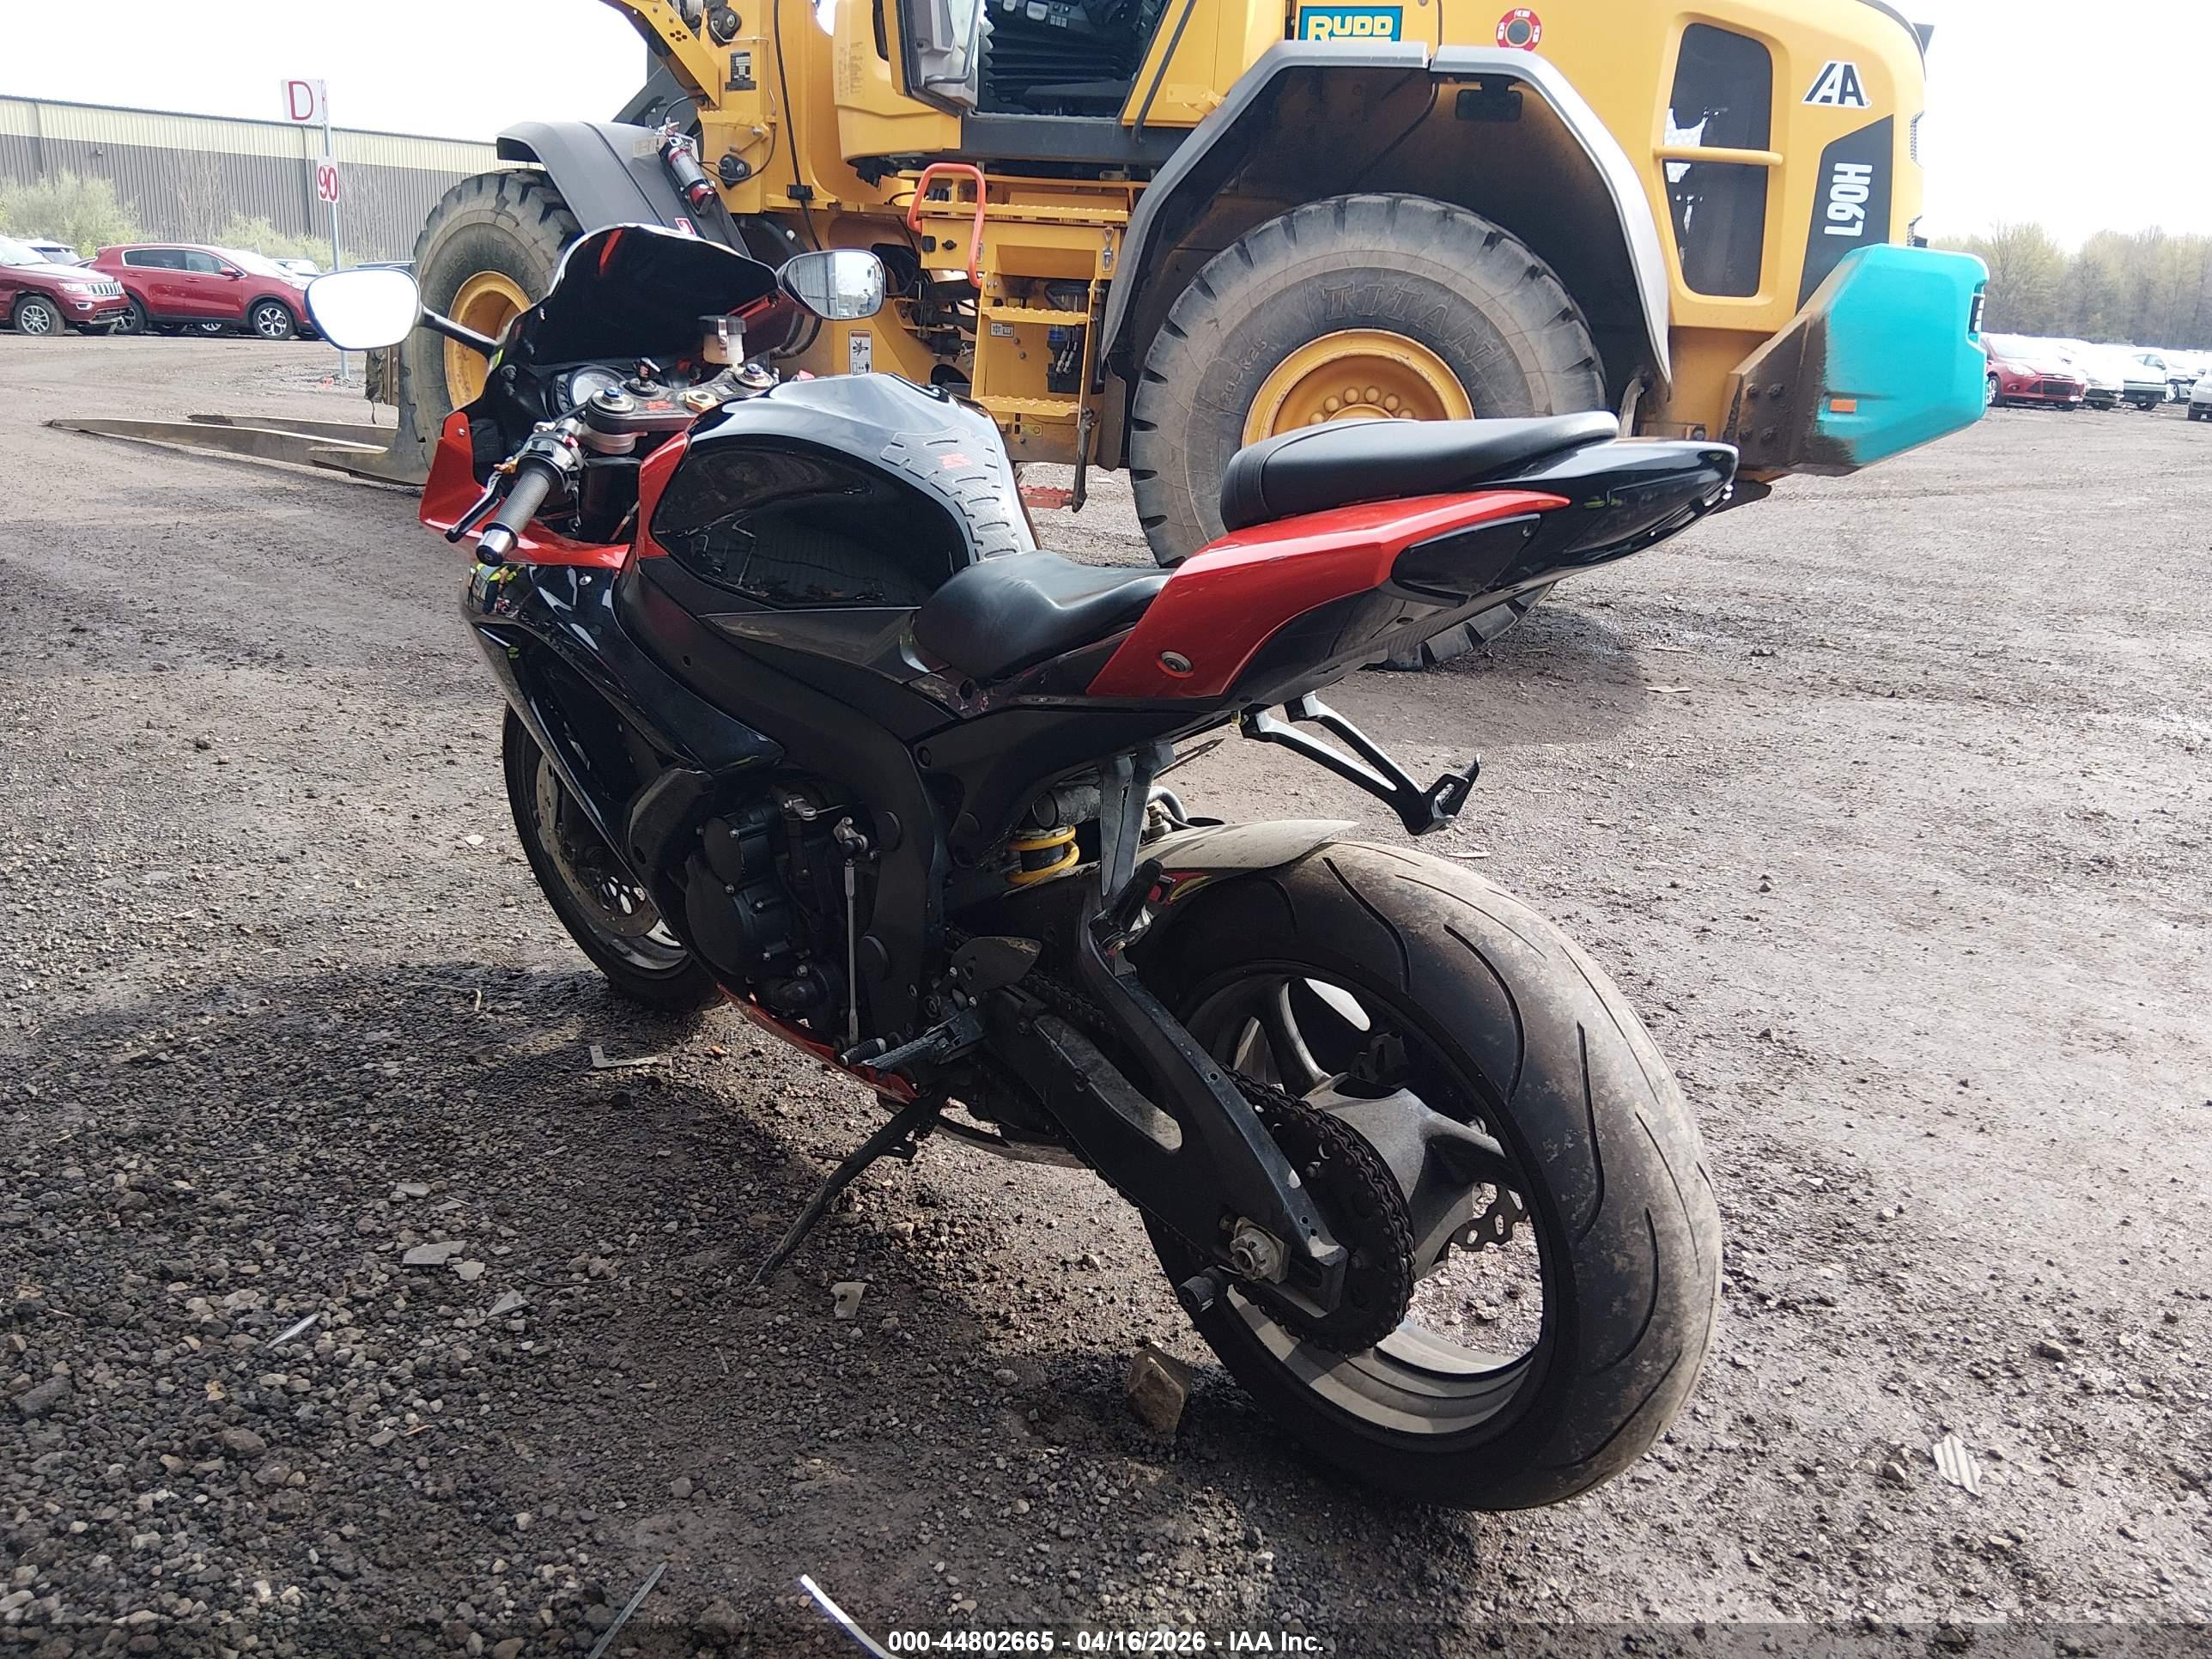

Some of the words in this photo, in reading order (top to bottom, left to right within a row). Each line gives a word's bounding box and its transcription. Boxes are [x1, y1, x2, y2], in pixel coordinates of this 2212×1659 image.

[1307, 15, 1394, 42] RUDD
[288, 80, 314, 121] D
[318, 166, 338, 202] 90
[1823, 162, 1874, 237] L90H
[1322, 281, 1495, 365] TITAN
